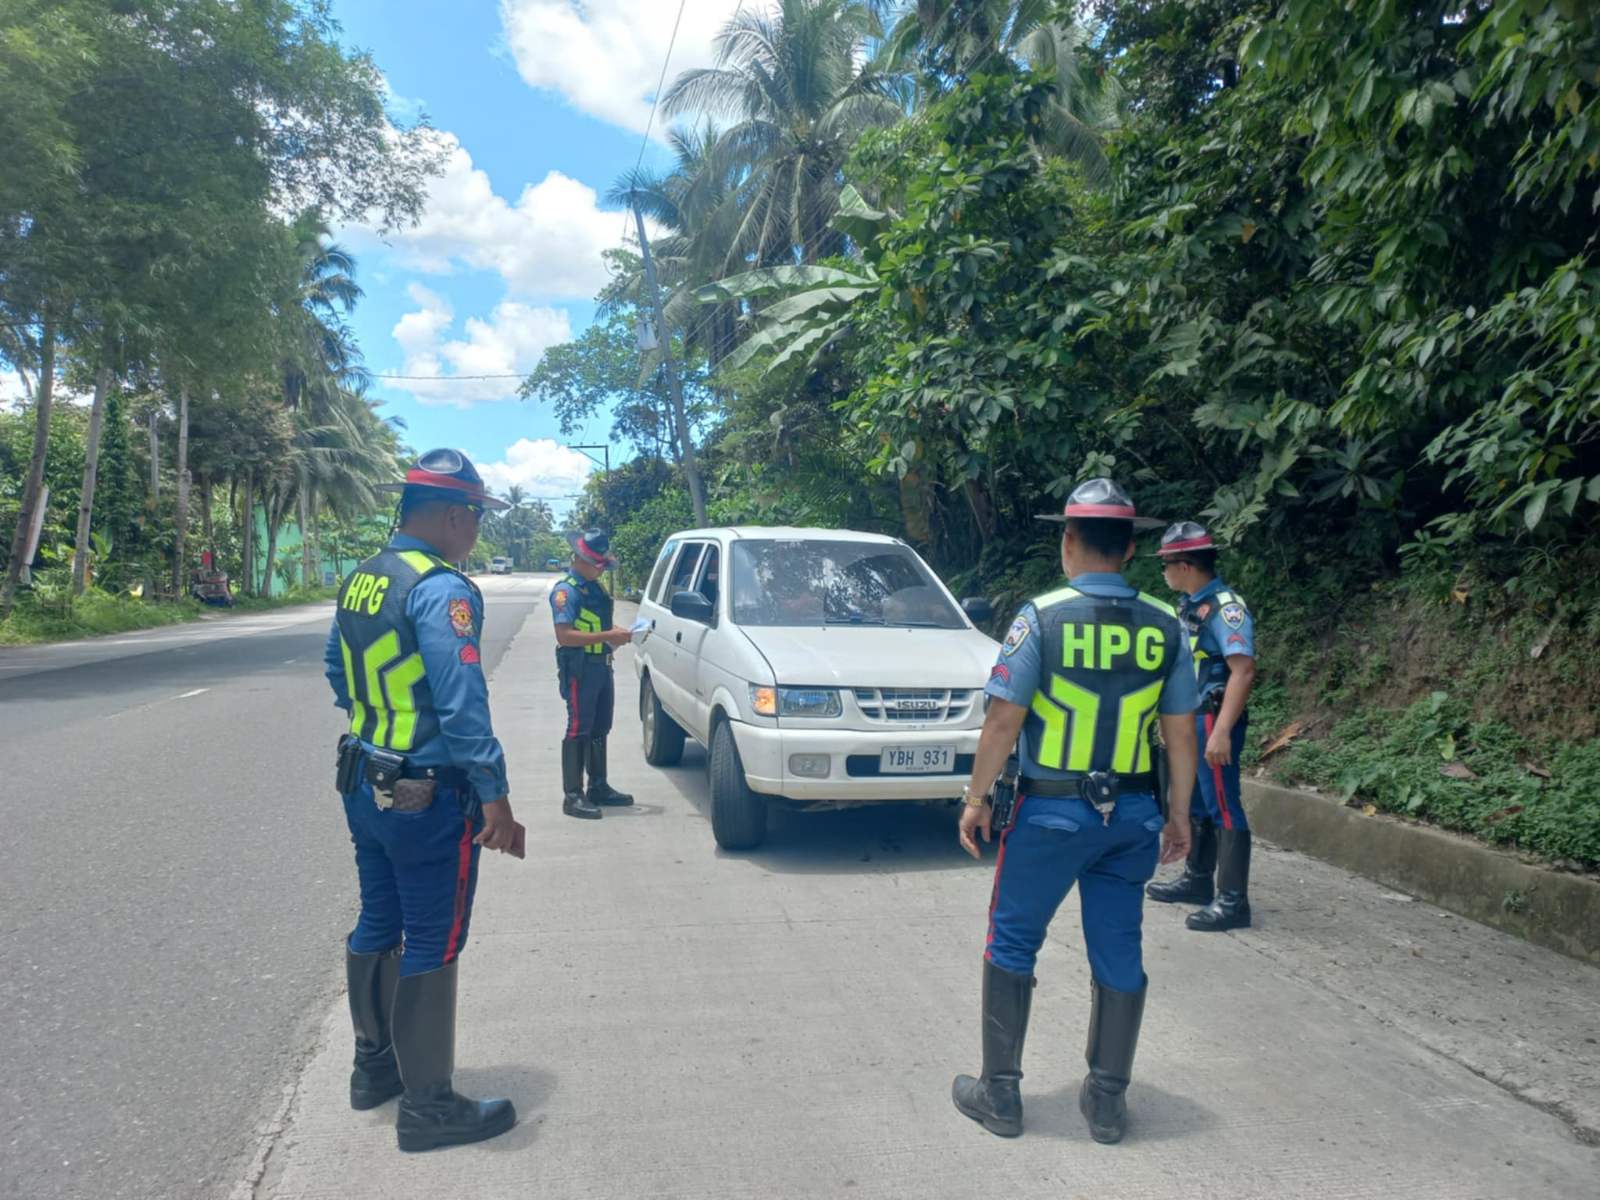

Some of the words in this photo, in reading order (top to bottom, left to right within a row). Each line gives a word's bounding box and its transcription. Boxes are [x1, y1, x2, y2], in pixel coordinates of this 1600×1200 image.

[343, 572, 389, 615] HPG
[1062, 623, 1165, 670] HPG
[897, 701, 937, 709] ISUZU
[889, 750, 914, 766] YBH
[923, 750, 948, 766] 931
